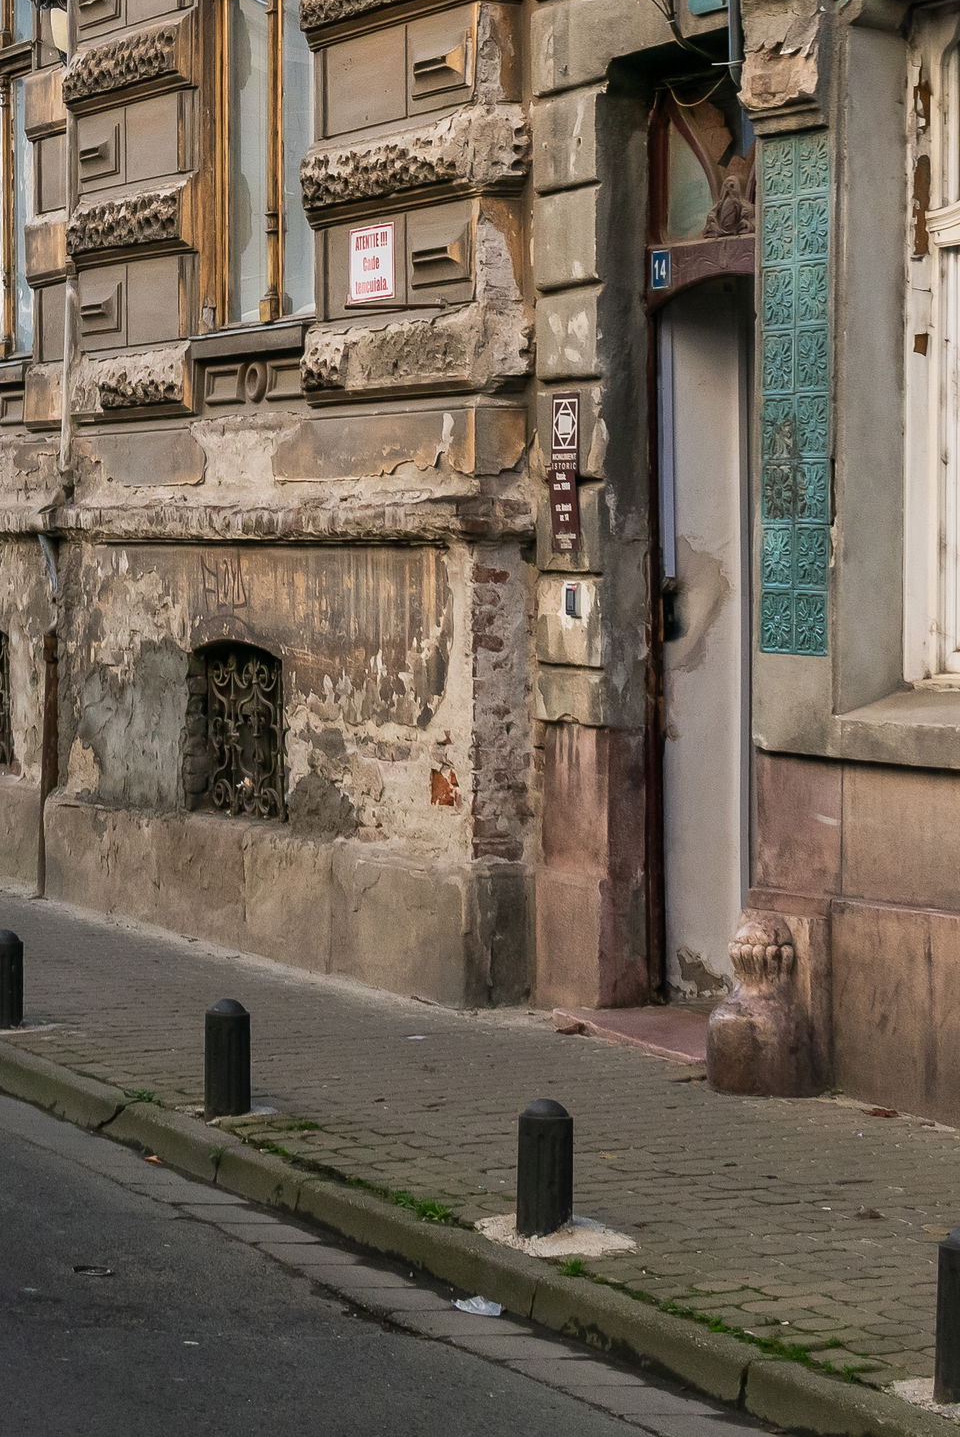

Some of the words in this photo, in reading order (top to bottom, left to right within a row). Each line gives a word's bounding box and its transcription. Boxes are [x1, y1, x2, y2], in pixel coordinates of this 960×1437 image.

[355, 232, 379, 251] ATENTIE
[654, 259, 667, 280] 14
[552, 453, 577, 461] MONUMENT
[551, 462, 577, 470] ISTORIC
